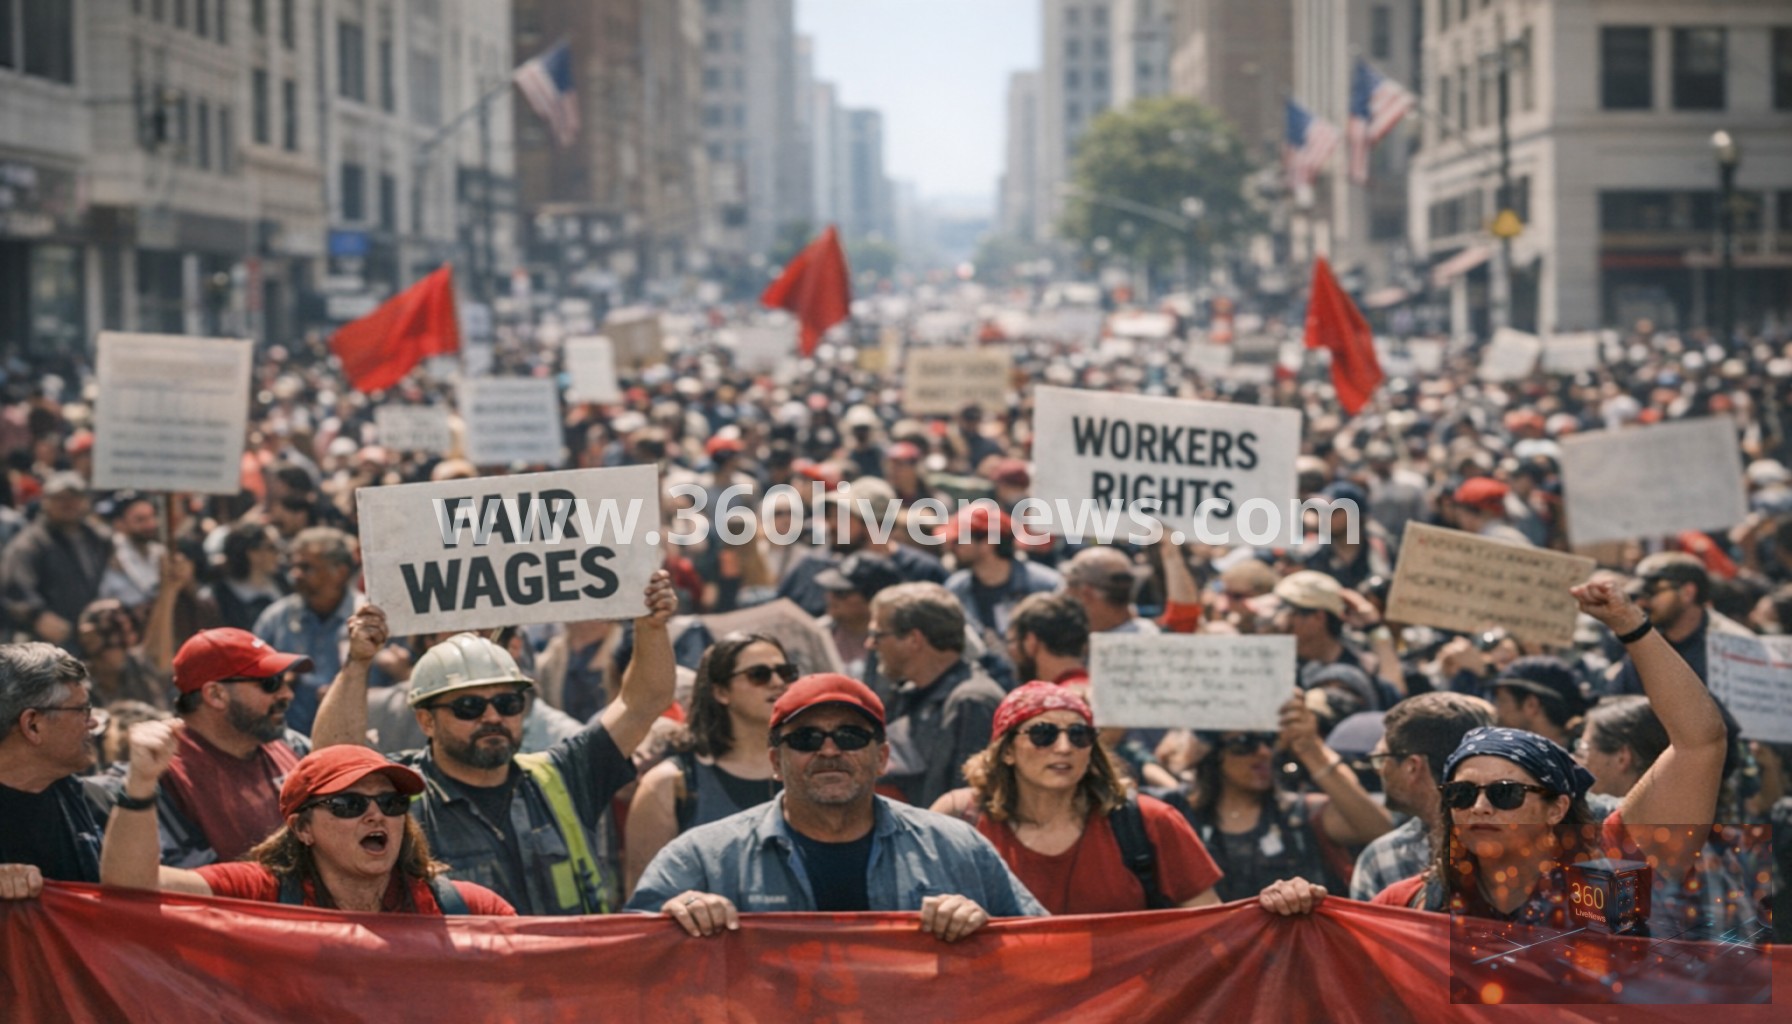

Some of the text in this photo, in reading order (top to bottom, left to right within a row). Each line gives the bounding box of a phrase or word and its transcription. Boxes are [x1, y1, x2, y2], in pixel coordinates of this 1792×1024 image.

[1072, 416, 1259, 471] WORKERS
[443, 488, 580, 549] FAIR
[1091, 471, 1235, 519] RIGHTS
[400, 546, 620, 614] WAGES
